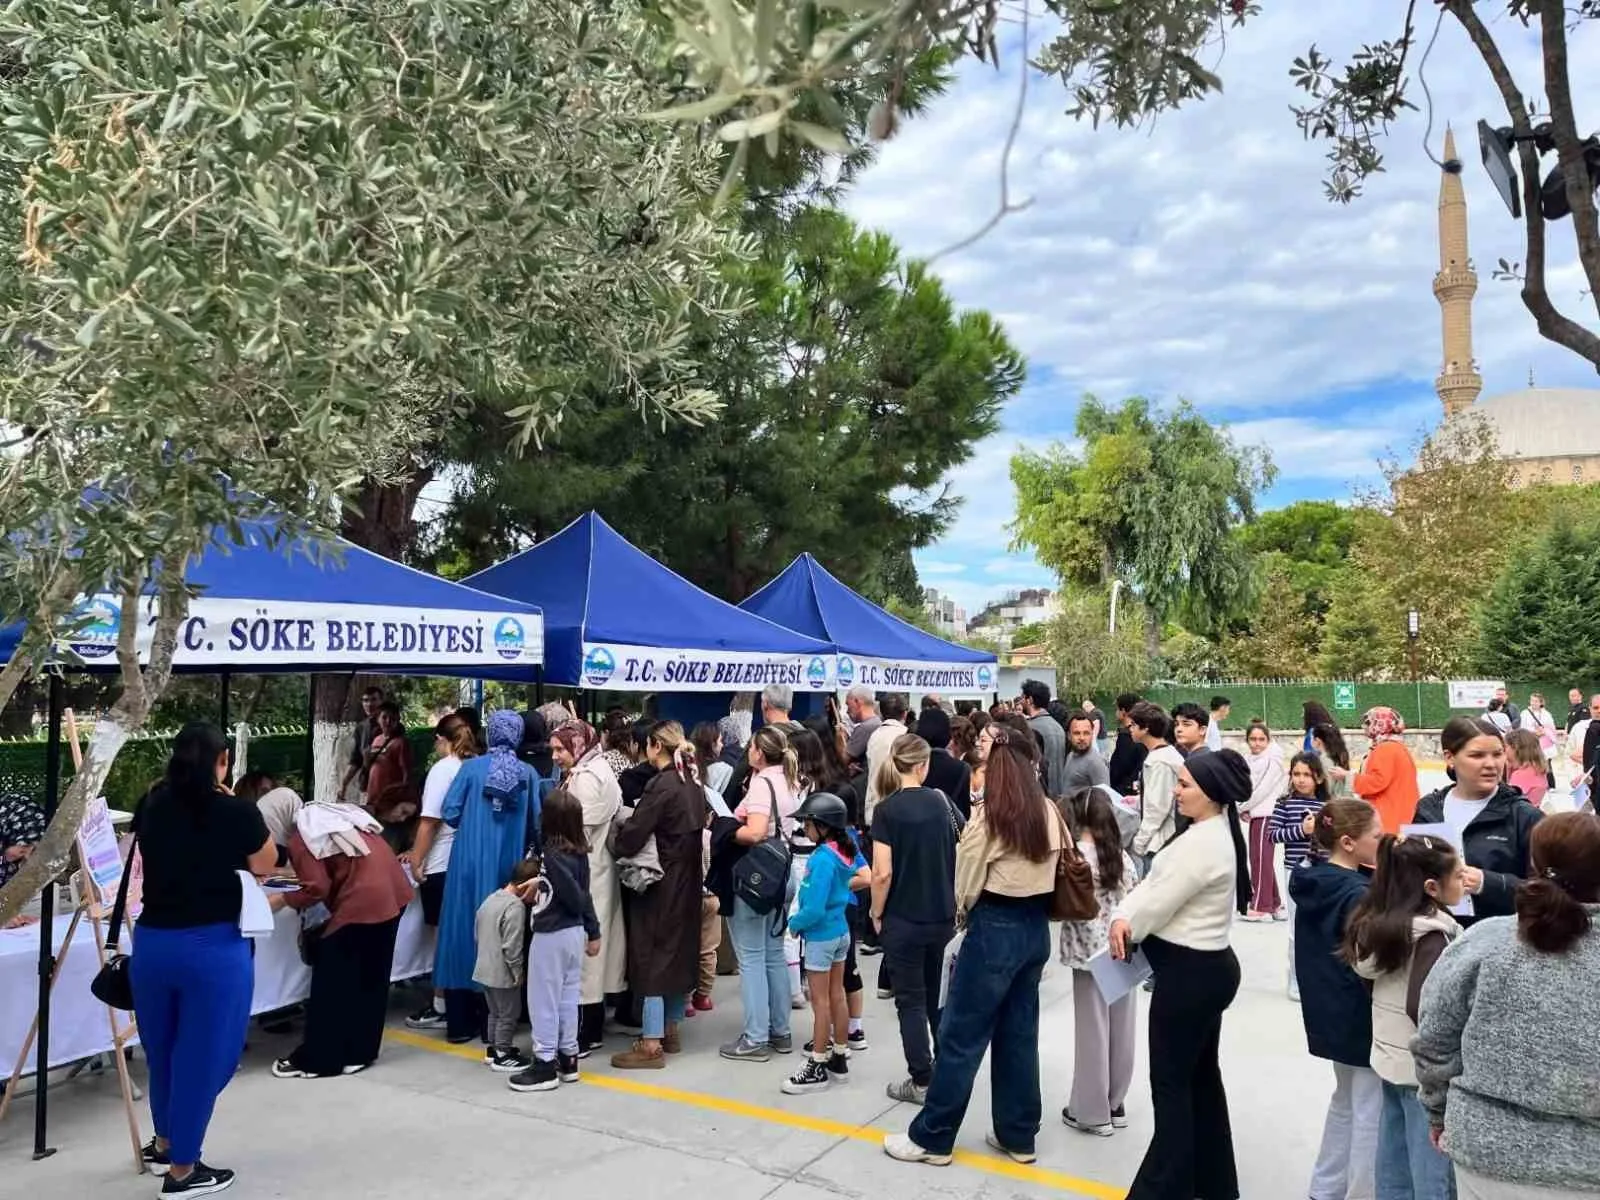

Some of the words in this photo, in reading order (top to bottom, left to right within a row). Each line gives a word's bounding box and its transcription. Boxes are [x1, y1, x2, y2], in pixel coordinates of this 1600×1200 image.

[228, 608, 316, 652] SÖKE
[326, 615, 484, 653] BELEDİYESİ
[624, 658, 657, 682] T.C.
[664, 654, 711, 683] SÖKE
[712, 658, 802, 684] BELEDİYESİ
[860, 665, 880, 684] T.C.
[883, 663, 915, 687] SÖKE
[915, 667, 975, 688] BELEDİYESİ
